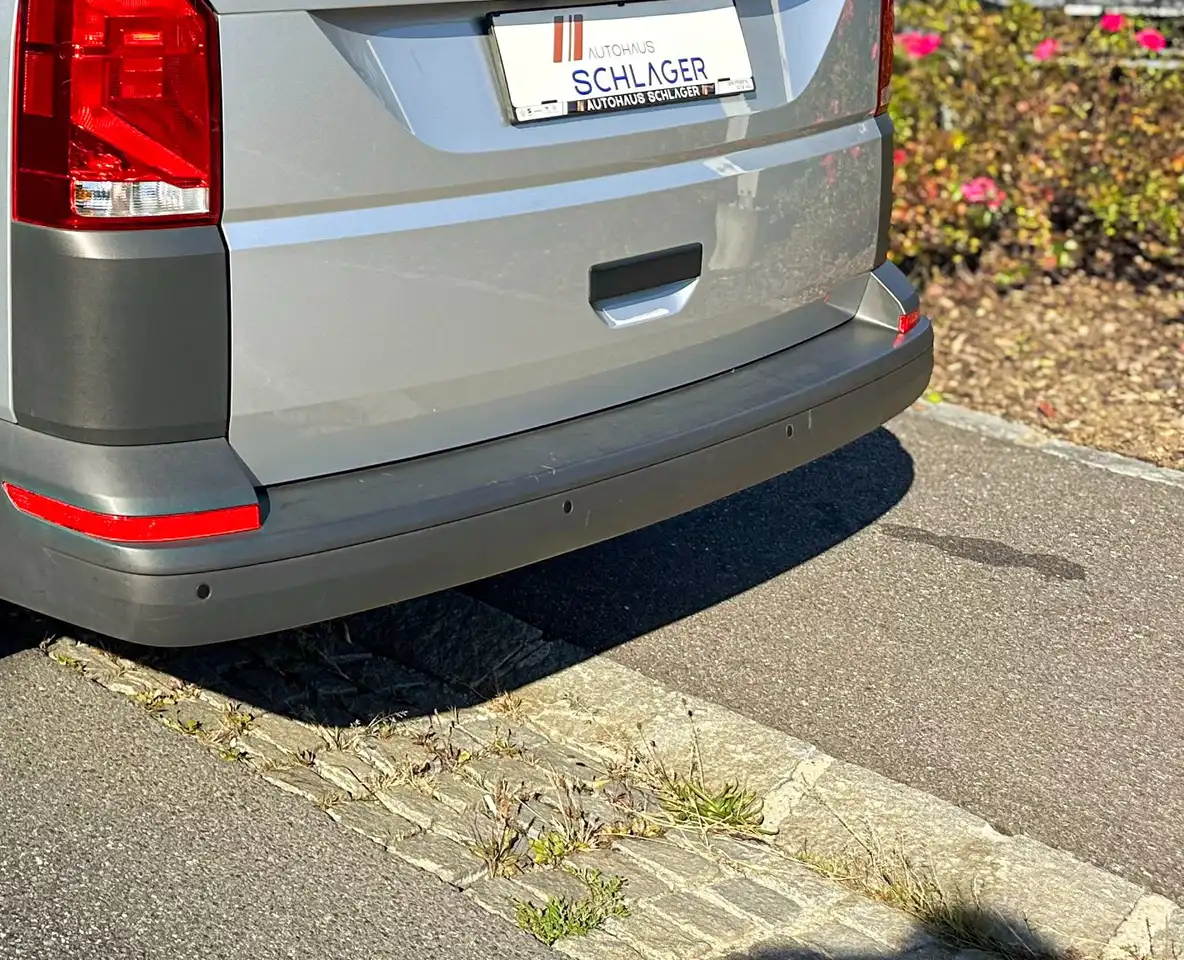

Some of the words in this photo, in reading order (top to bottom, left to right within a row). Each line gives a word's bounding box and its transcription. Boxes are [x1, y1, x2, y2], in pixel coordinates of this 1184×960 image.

[588, 40, 655, 60] AUTOHAUS
[572, 57, 708, 95] SCHLAGER
[587, 93, 646, 111] AUTOHAUS
[647, 86, 701, 103] SCHLAGER
